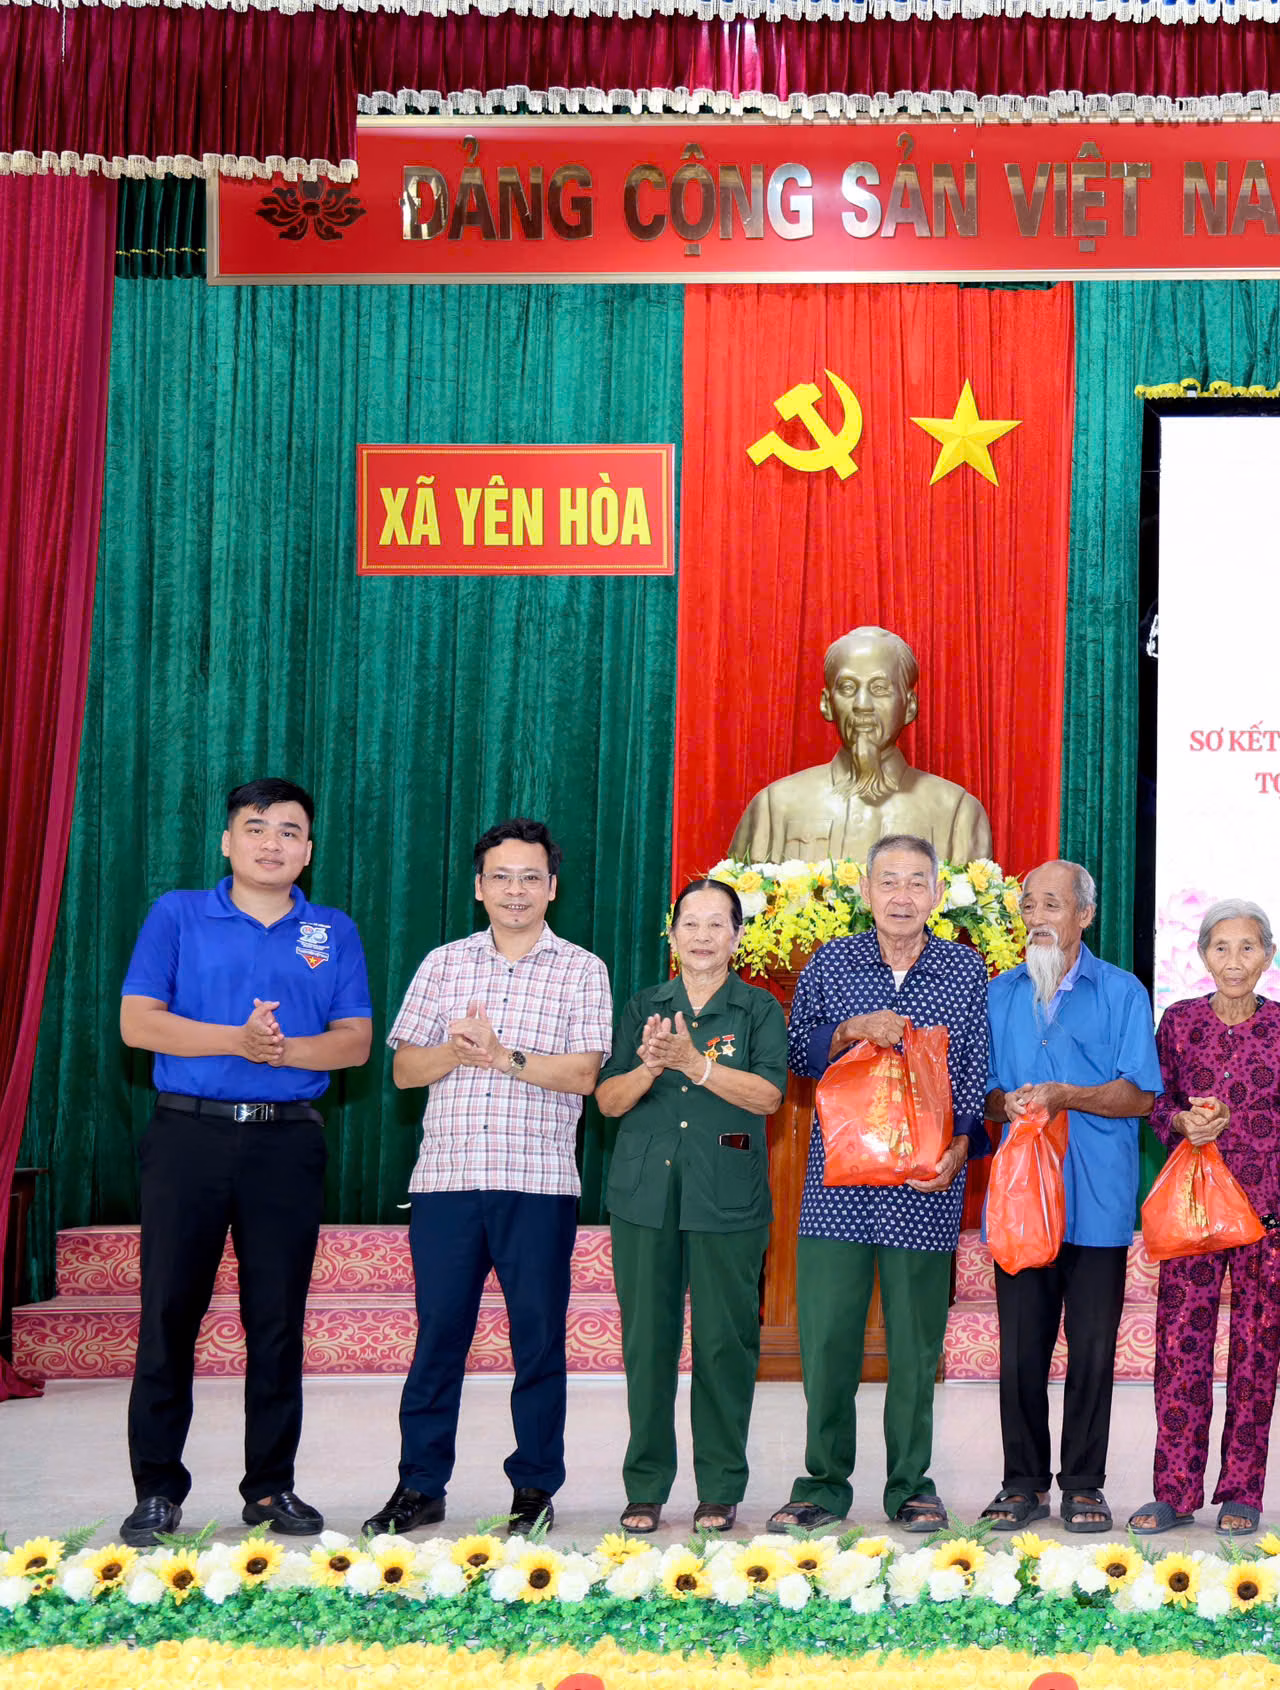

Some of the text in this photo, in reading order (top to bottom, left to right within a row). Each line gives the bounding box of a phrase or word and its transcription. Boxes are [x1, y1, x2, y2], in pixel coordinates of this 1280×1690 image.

[399, 134, 594, 241] ĐẢNG
[623, 143, 814, 256] CỘNG
[841, 132, 978, 239] SẢN
[1004, 141, 1152, 252] VIỆT
[379, 472, 652, 546] XÃ YÊN HÒA
[1189, 727, 1224, 752] SƠ
[1228, 720, 1280, 752] KẾT
